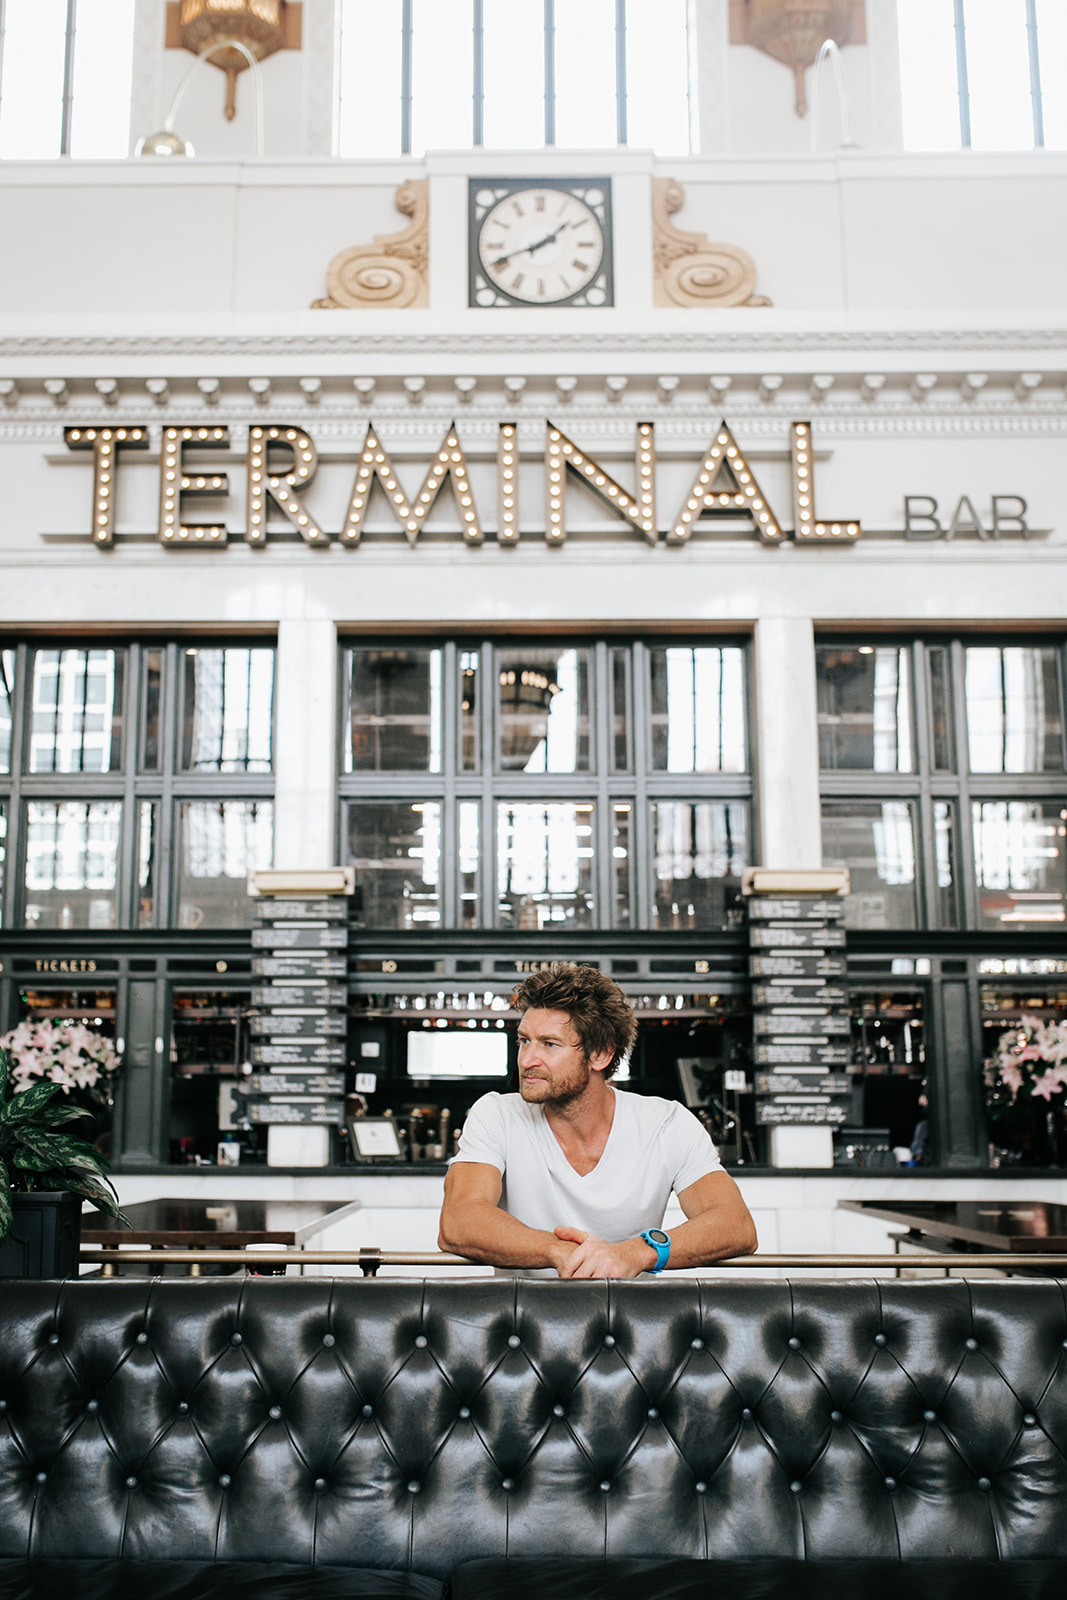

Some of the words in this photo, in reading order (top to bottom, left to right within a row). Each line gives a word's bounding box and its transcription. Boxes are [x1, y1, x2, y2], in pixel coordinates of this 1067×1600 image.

[64, 418, 862, 548] TERMINAL
[904, 495, 1029, 541] BAR
[35, 959, 97, 973] TICKETS
